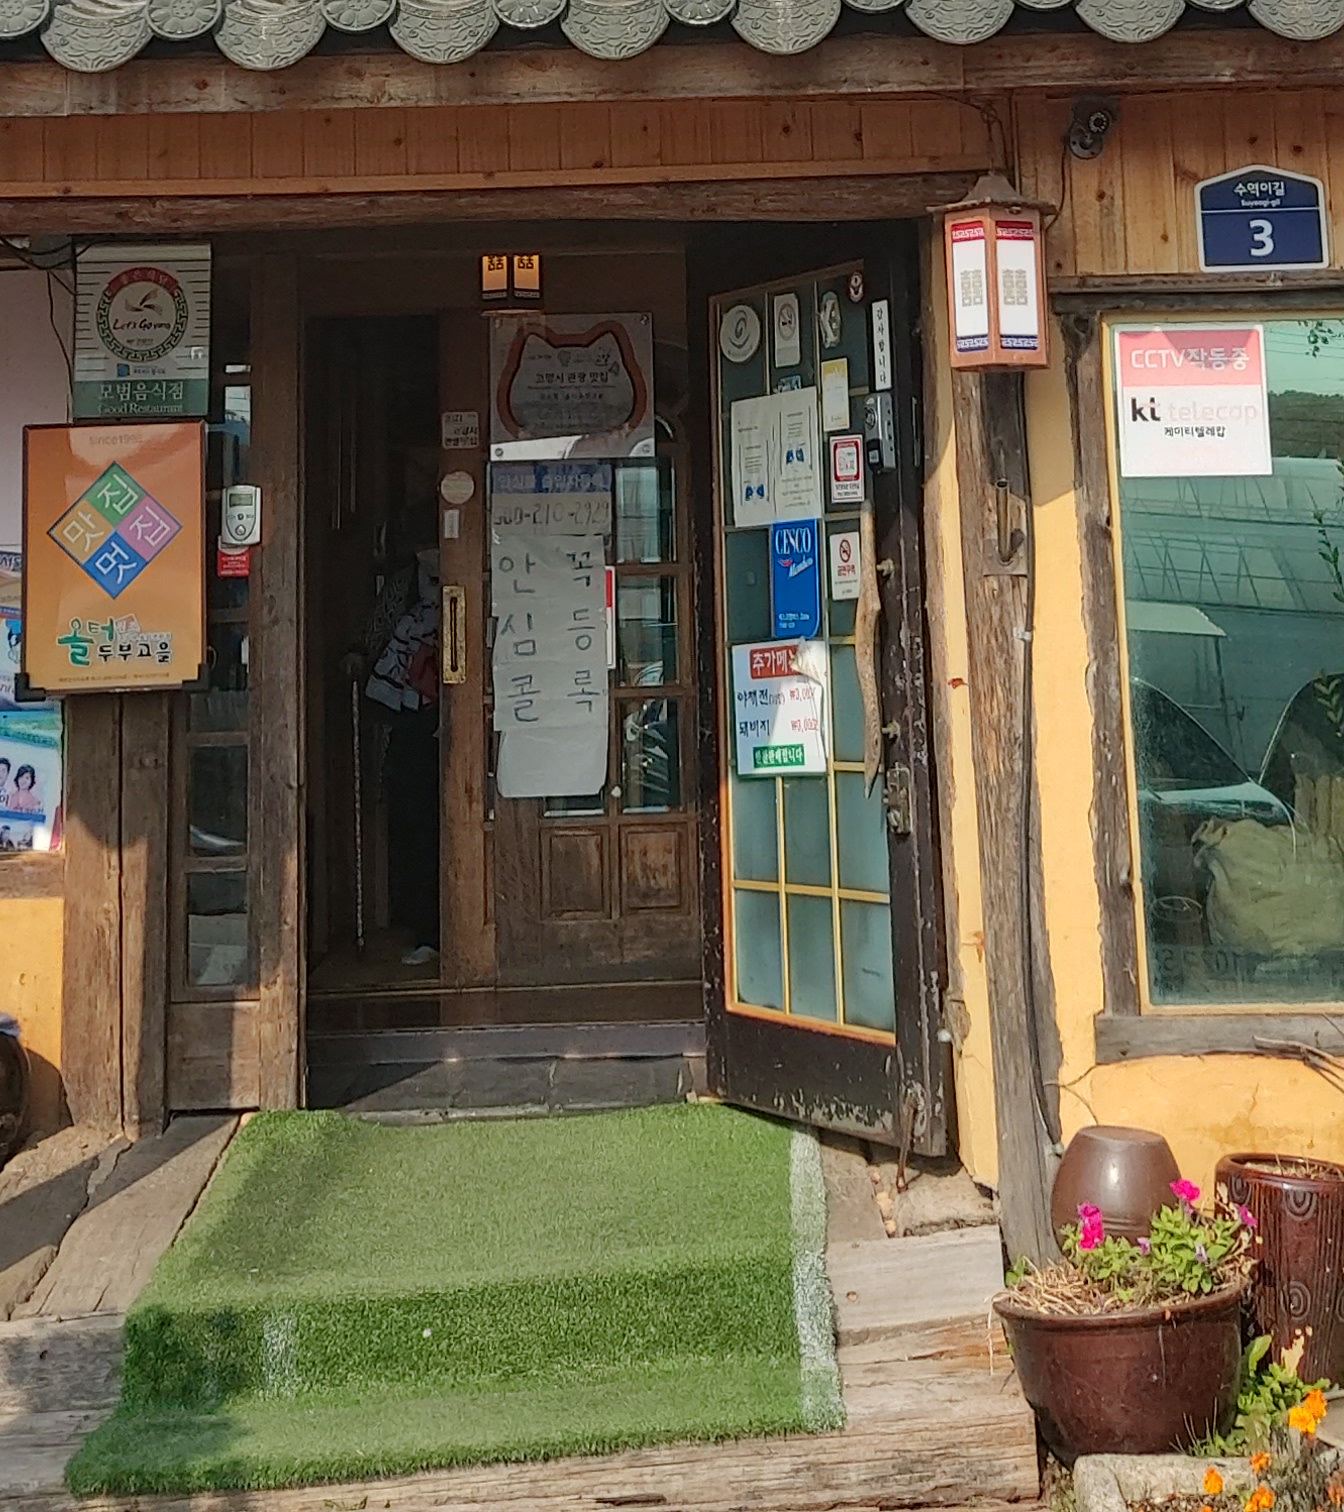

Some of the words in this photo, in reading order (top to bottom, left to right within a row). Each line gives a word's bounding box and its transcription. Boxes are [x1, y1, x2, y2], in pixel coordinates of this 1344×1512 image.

[1233, 181, 1286, 198] 수역이길
[1248, 218, 1275, 257] 3
[875, 306, 888, 385] 감사합니다
[1130, 347, 1250, 372] CCTV작동중
[98, 380, 184, 402] 모범음식점
[1130, 396, 1161, 422] kt
[774, 526, 812, 555] CESCO
[98, 641, 173, 663] 두부고을
